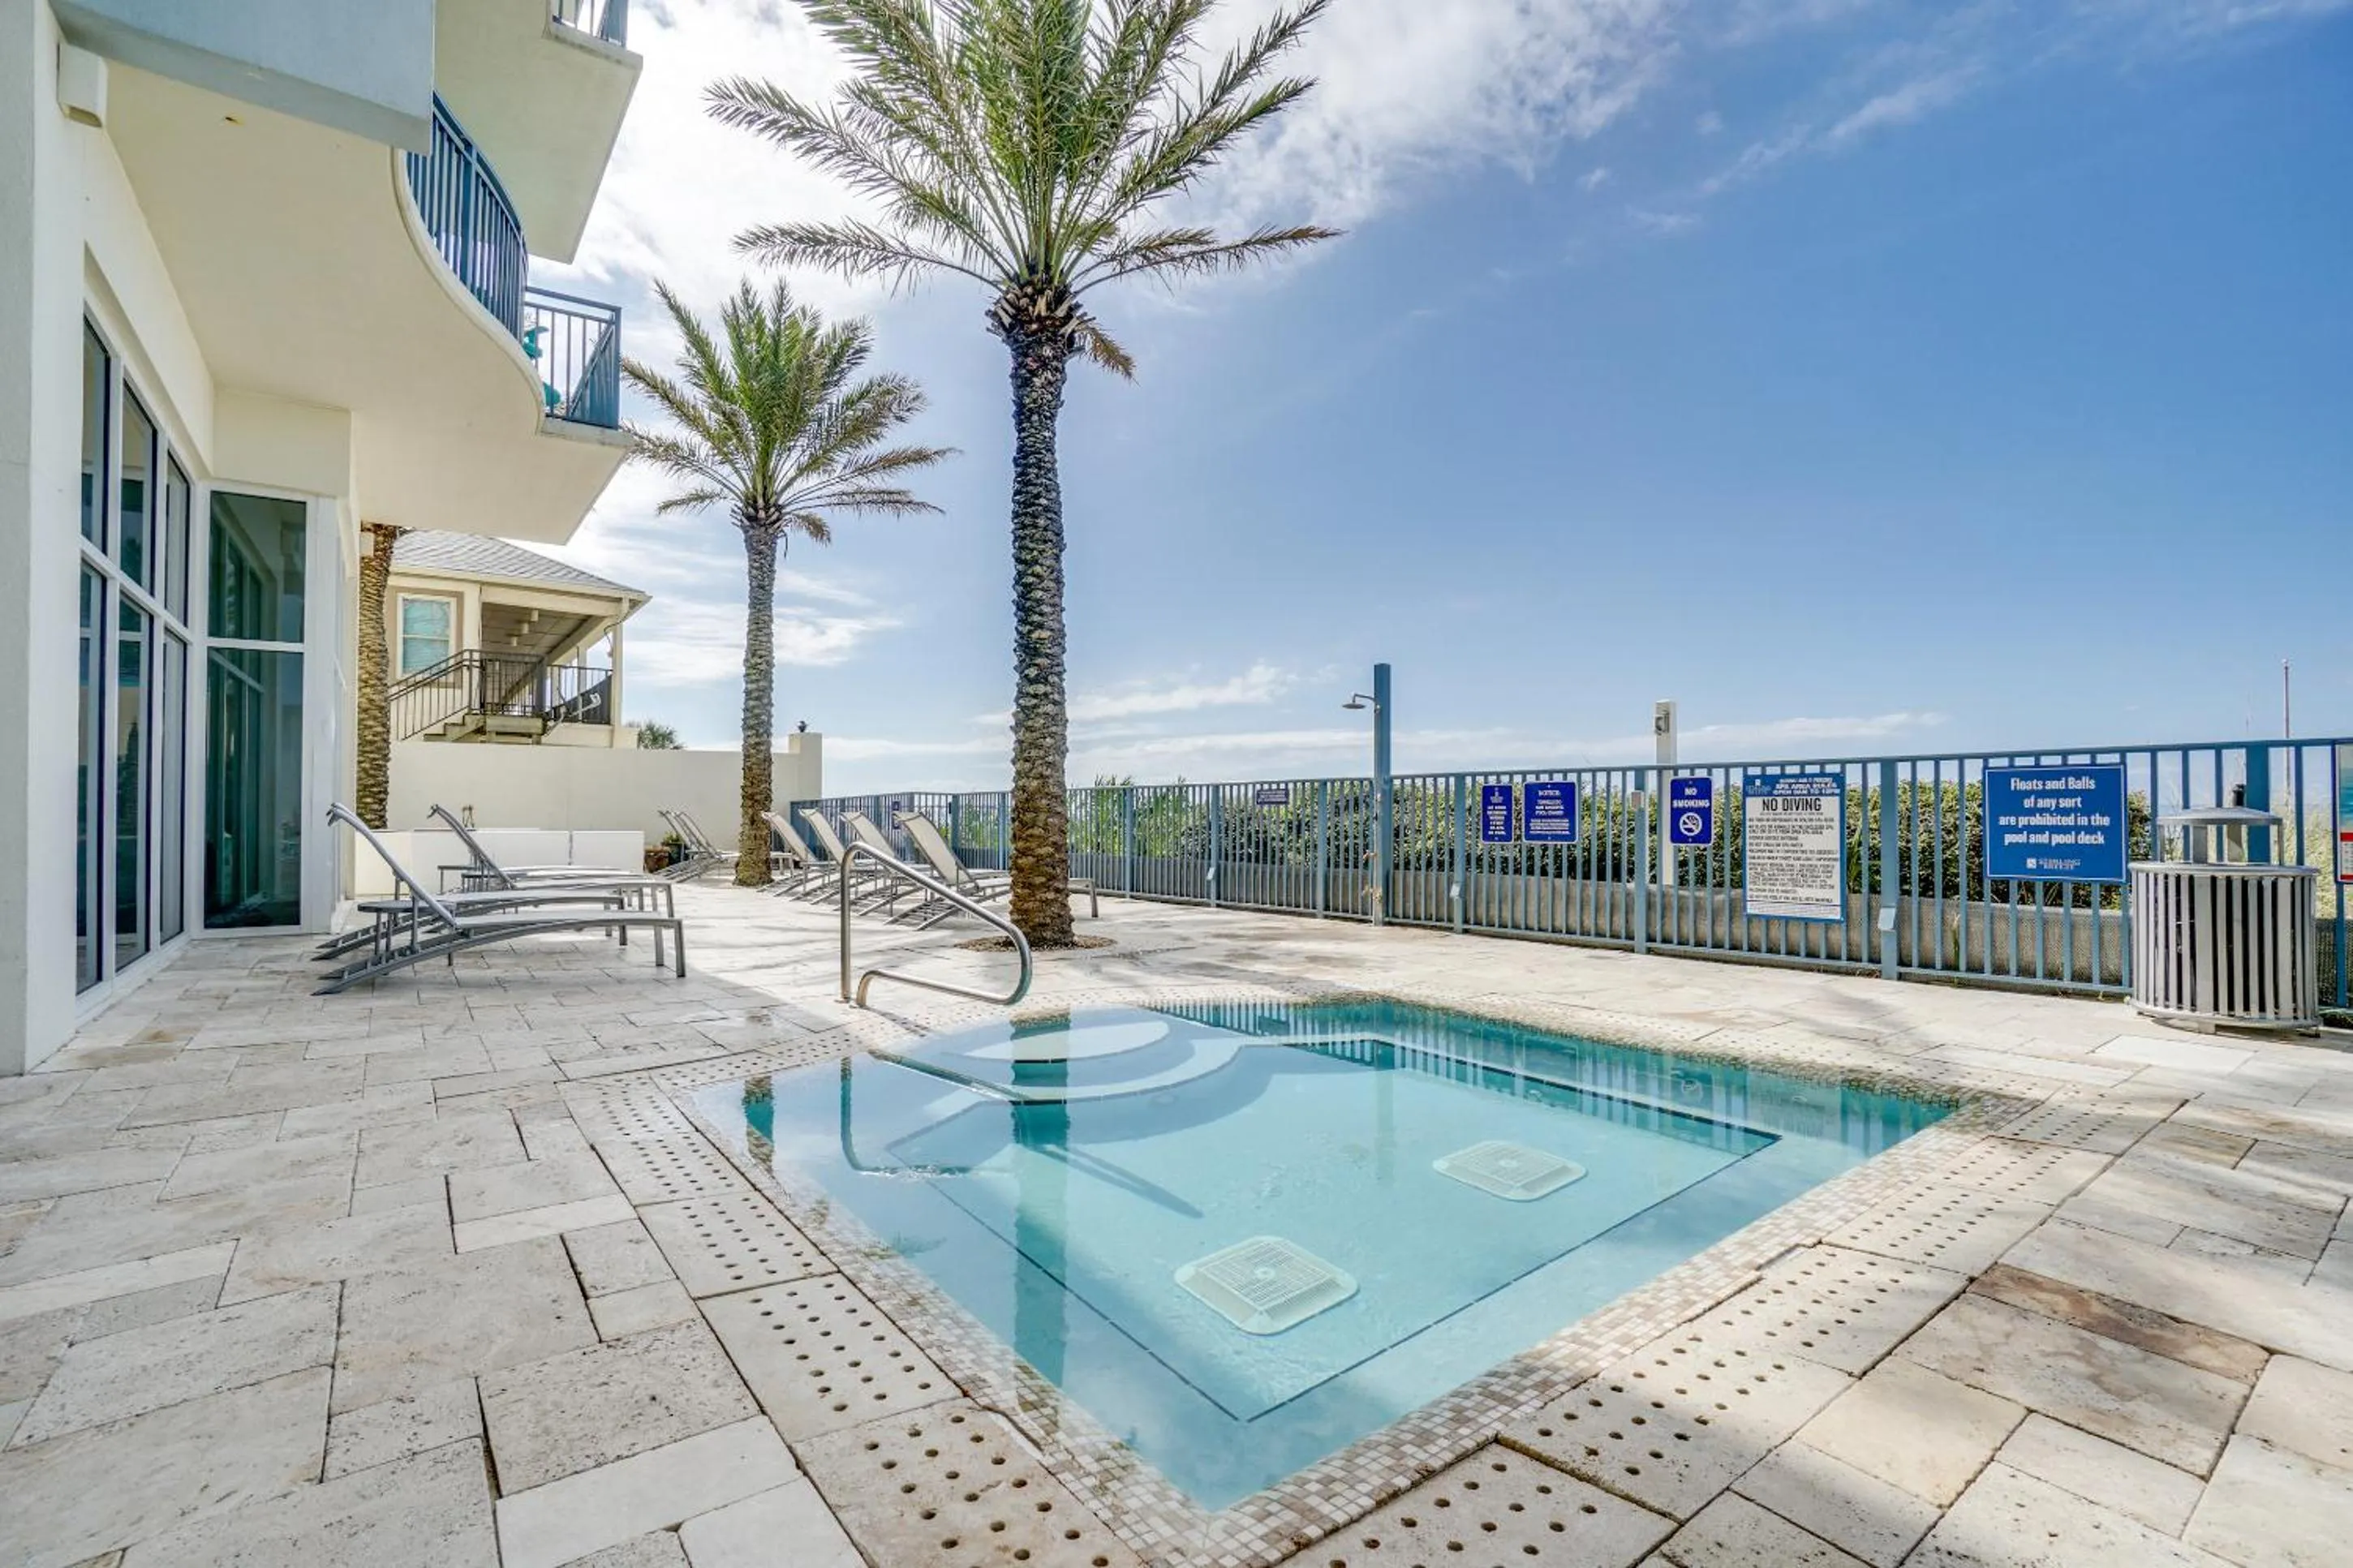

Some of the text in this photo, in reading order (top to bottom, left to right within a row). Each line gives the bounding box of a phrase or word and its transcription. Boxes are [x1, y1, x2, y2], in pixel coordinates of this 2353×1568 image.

[2011, 776, 2096, 791] Floats and Balls
[1684, 788, 1697, 796] NO
[1672, 799, 1710, 808] SMOKING
[1762, 797, 1822, 811] NO DIVING
[2023, 795, 2082, 810] of any sort
[1998, 813, 2110, 828] are prohibited in the
[2004, 831, 2105, 846] pool and pool deck
